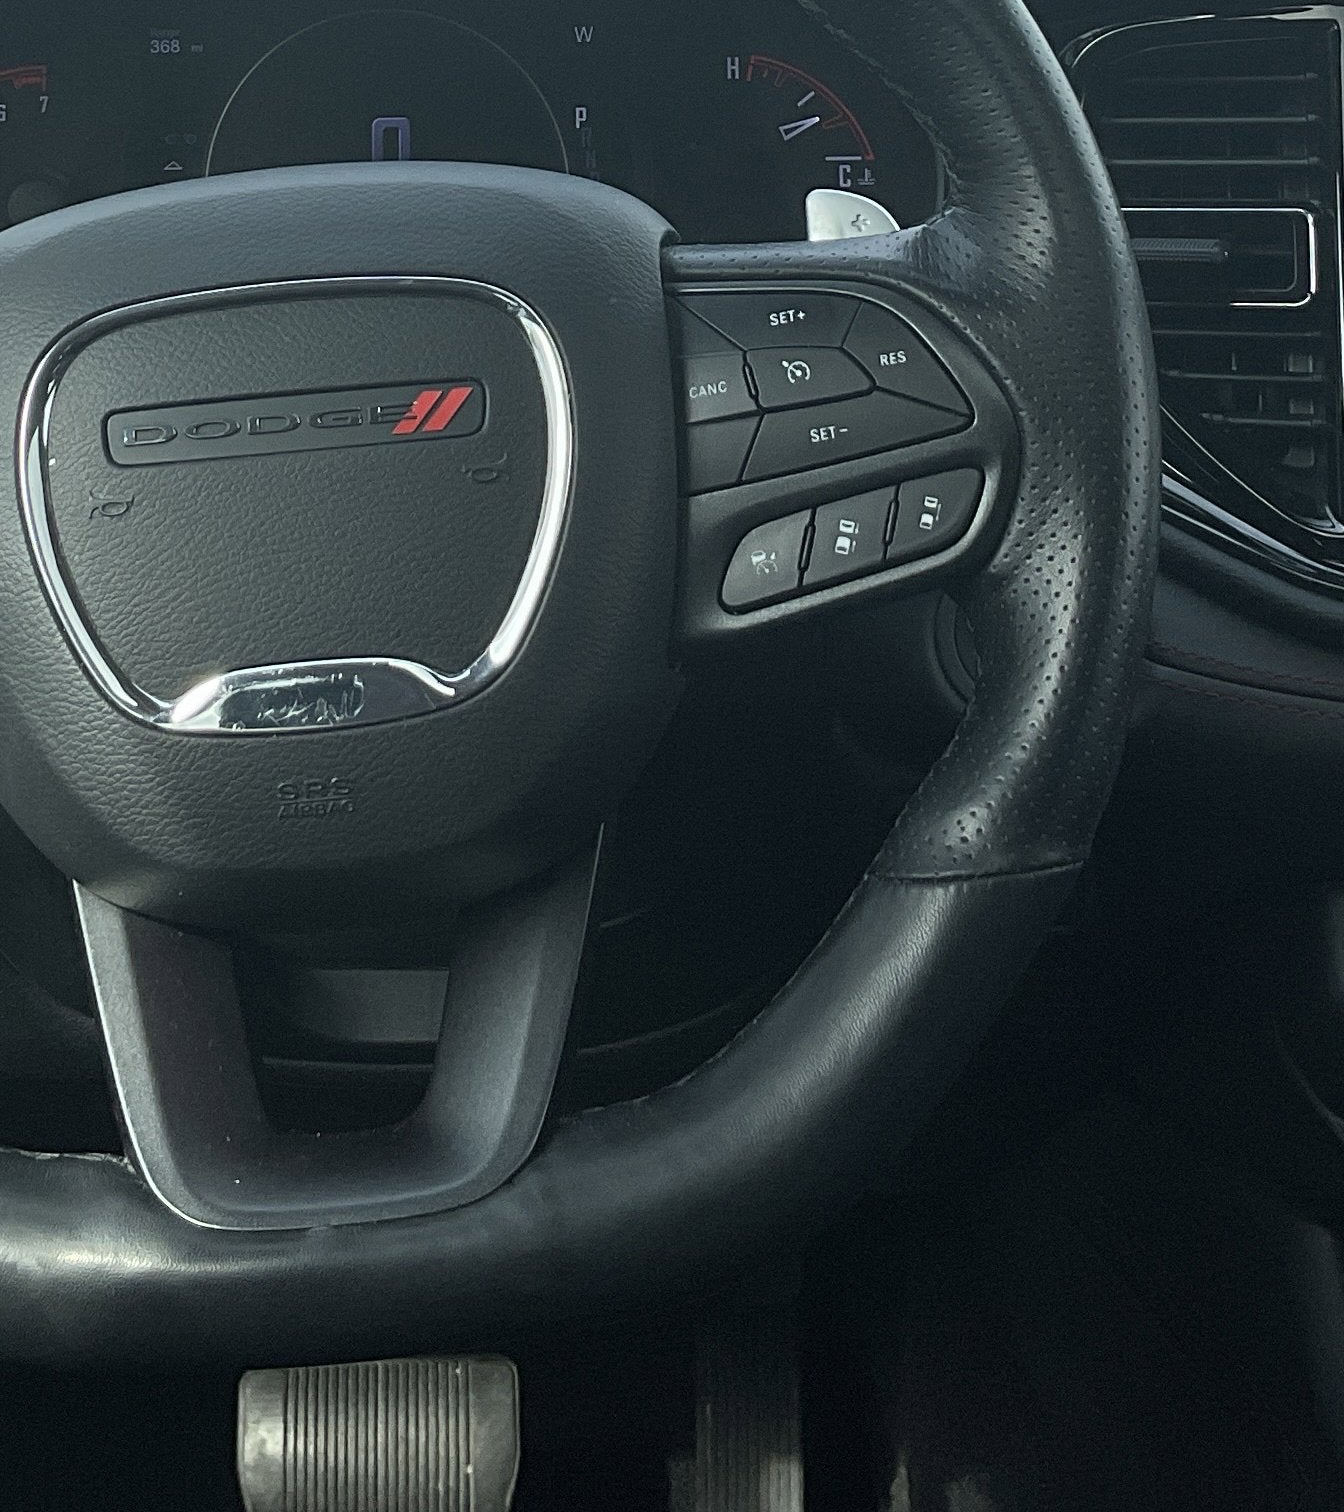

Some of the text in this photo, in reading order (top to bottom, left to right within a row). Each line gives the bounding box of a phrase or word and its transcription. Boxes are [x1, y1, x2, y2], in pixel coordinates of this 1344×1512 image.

[573, 26, 594, 42] W
[150, 39, 181, 53] 368
[726, 56, 740, 79] H
[39, 95, 49, 113] 7
[574, 106, 587, 129] P
[838, 164, 852, 188] C
[879, 351, 907, 367] RES
[689, 381, 728, 399] CANC
[123, 400, 419, 448] DODGE
